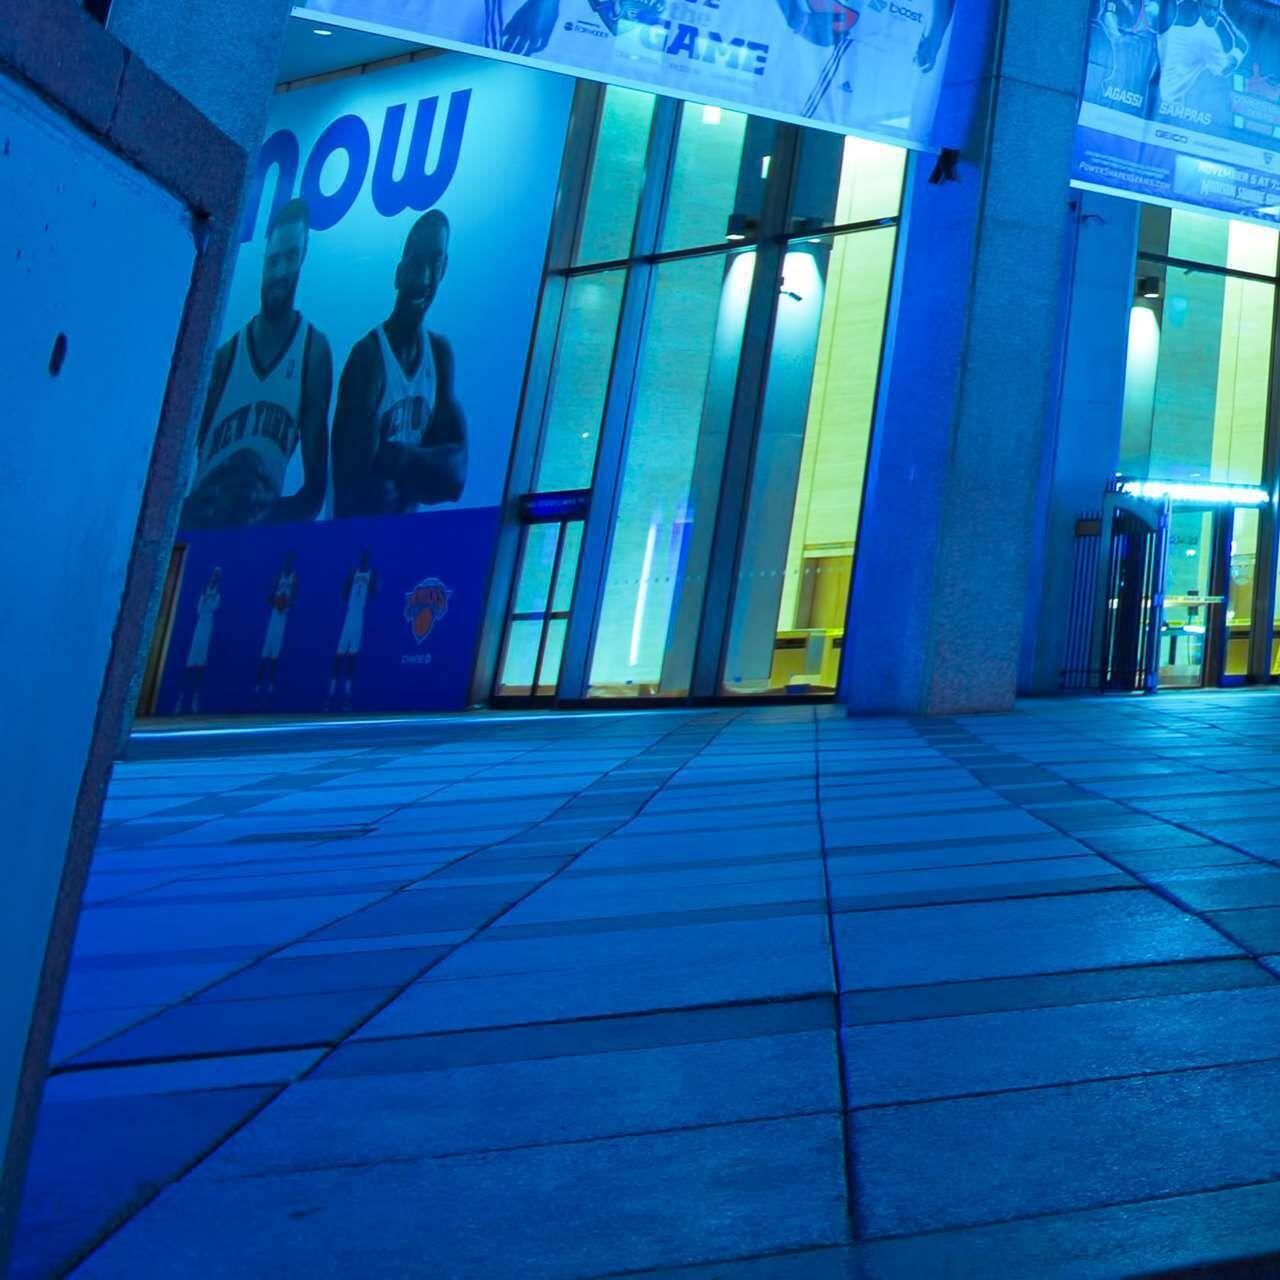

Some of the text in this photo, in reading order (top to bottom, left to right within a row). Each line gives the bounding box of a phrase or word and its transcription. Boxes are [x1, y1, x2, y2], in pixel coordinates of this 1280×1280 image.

[889, 2, 923, 23] boost
[639, 19, 769, 76] GAME
[1103, 86, 1144, 109] AGASSI
[1158, 100, 1214, 126] SAMPRAS
